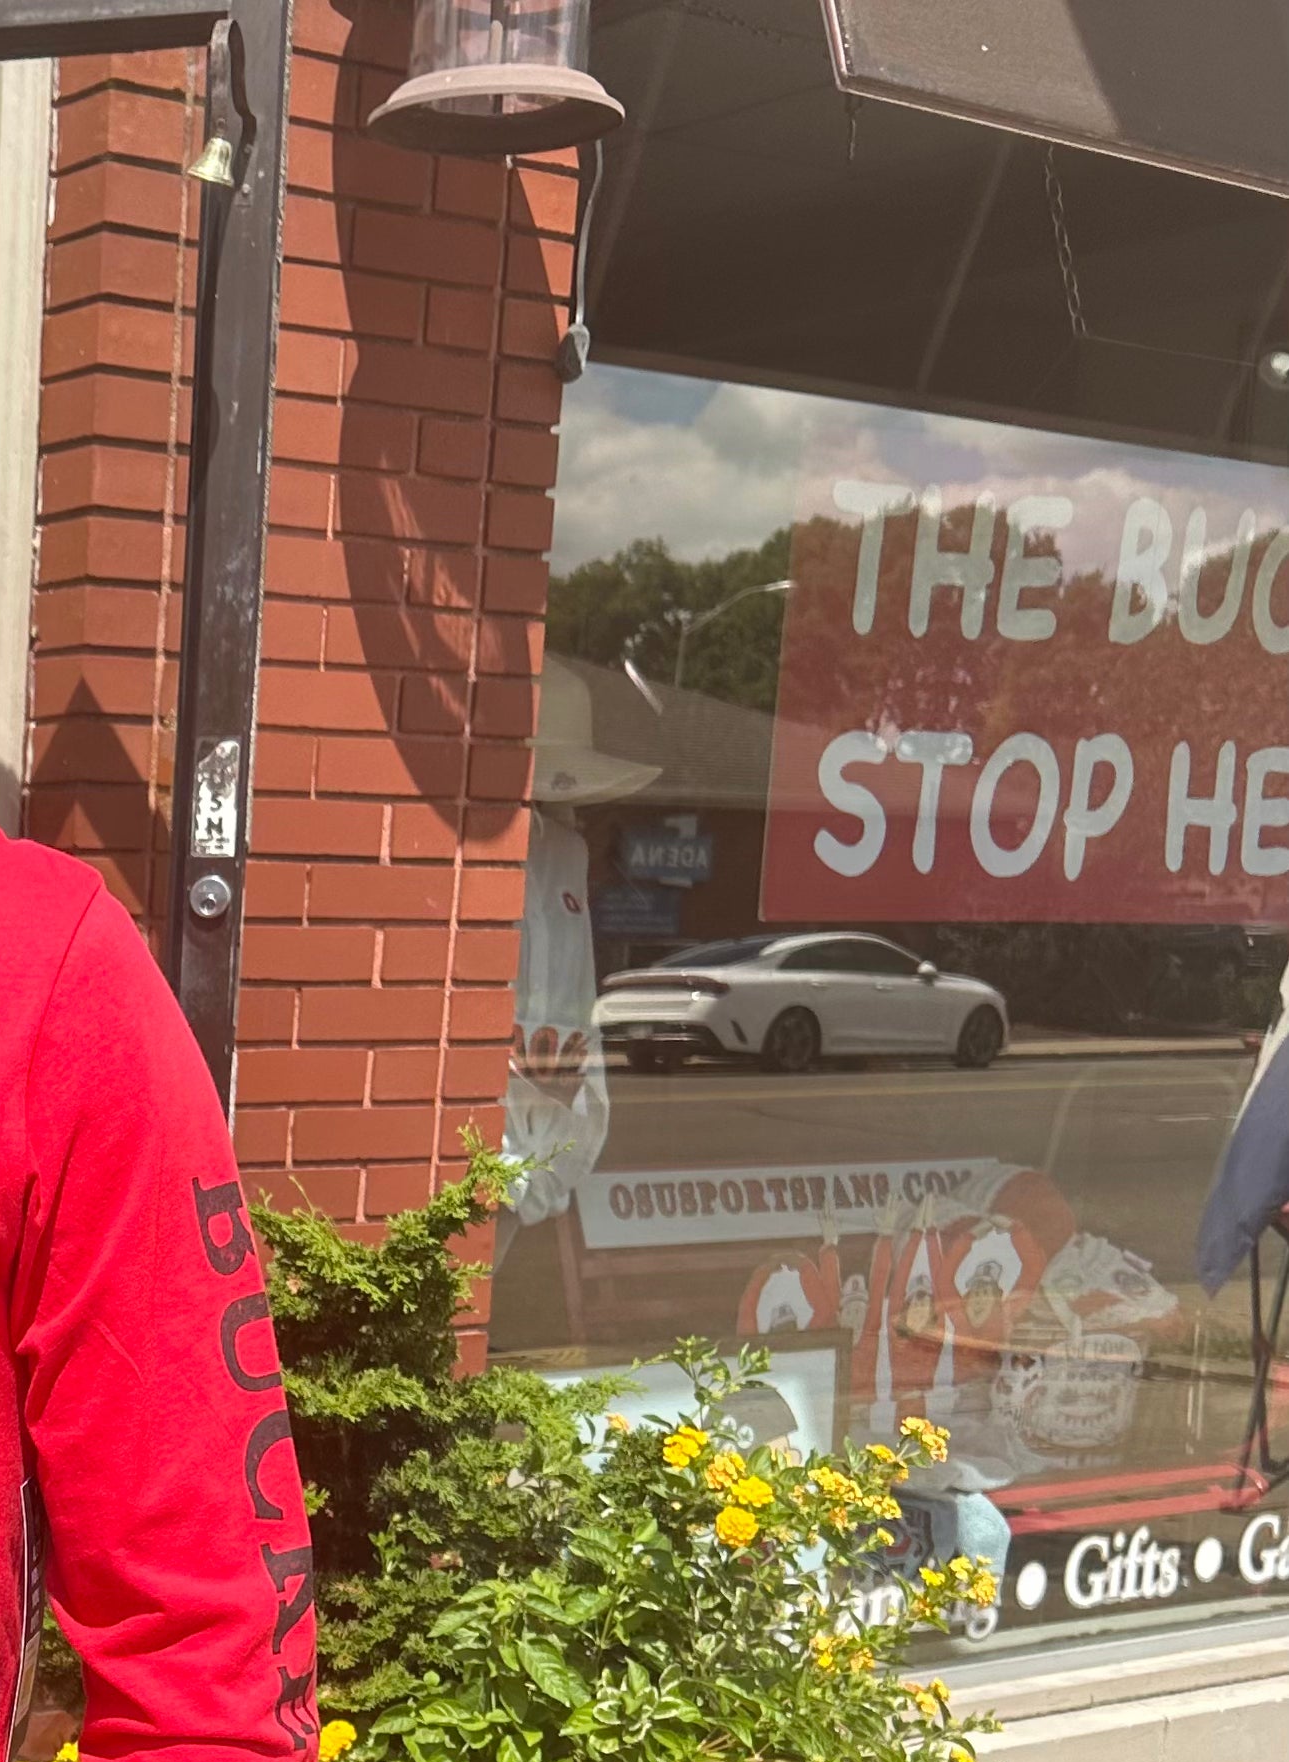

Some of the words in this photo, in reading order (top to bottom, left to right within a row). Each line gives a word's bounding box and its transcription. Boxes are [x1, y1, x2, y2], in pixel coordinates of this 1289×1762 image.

[833, 480, 1073, 641] THE
[814, 730, 1135, 882] STOP
[1165, 740, 1289, 876] HE
[1064, 1525, 1181, 1609] Gifts
